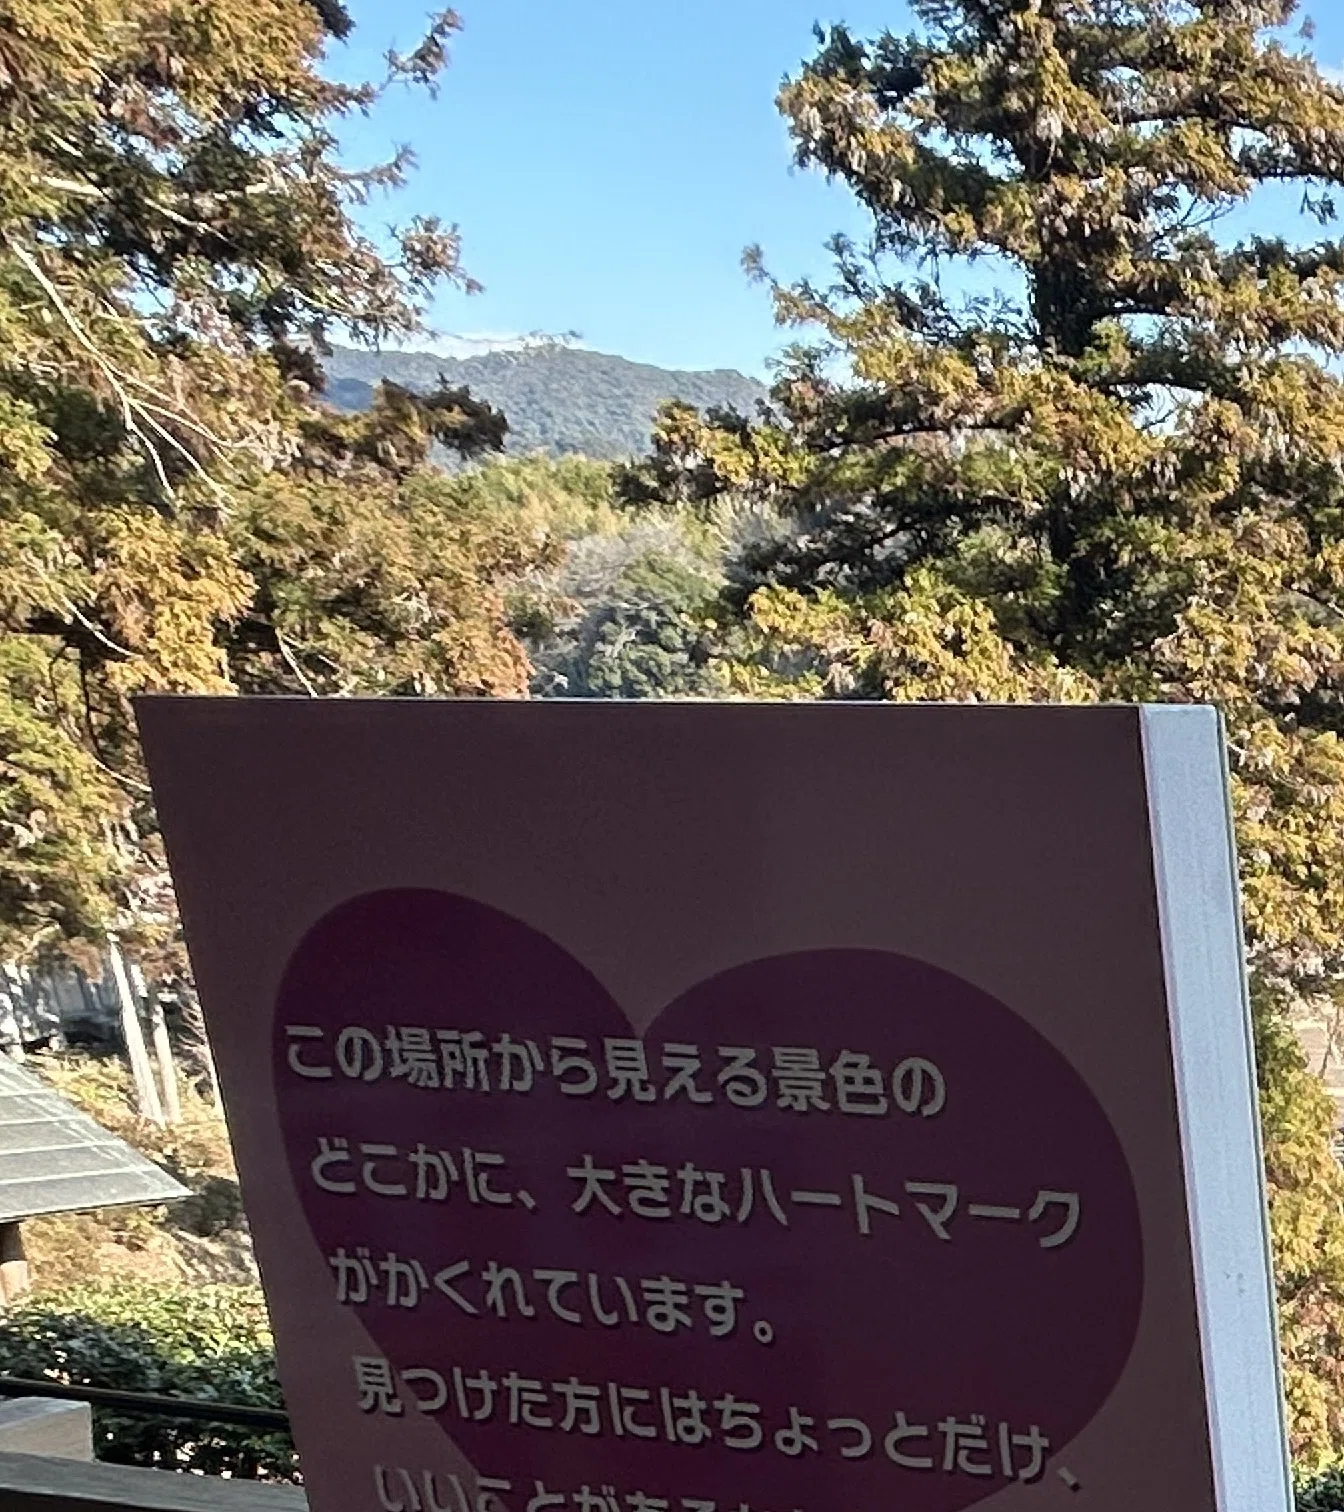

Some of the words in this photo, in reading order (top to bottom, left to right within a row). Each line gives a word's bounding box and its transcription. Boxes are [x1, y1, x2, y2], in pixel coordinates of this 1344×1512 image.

[285, 1024, 946, 1118] この場所から見える景色の
[310, 1136, 1081, 1249] どこかに、大きなハートマーク
[331, 1248, 776, 1344] がかくれています。
[353, 1355, 1082, 1491] 見つけた方にはちょっとだけ、
